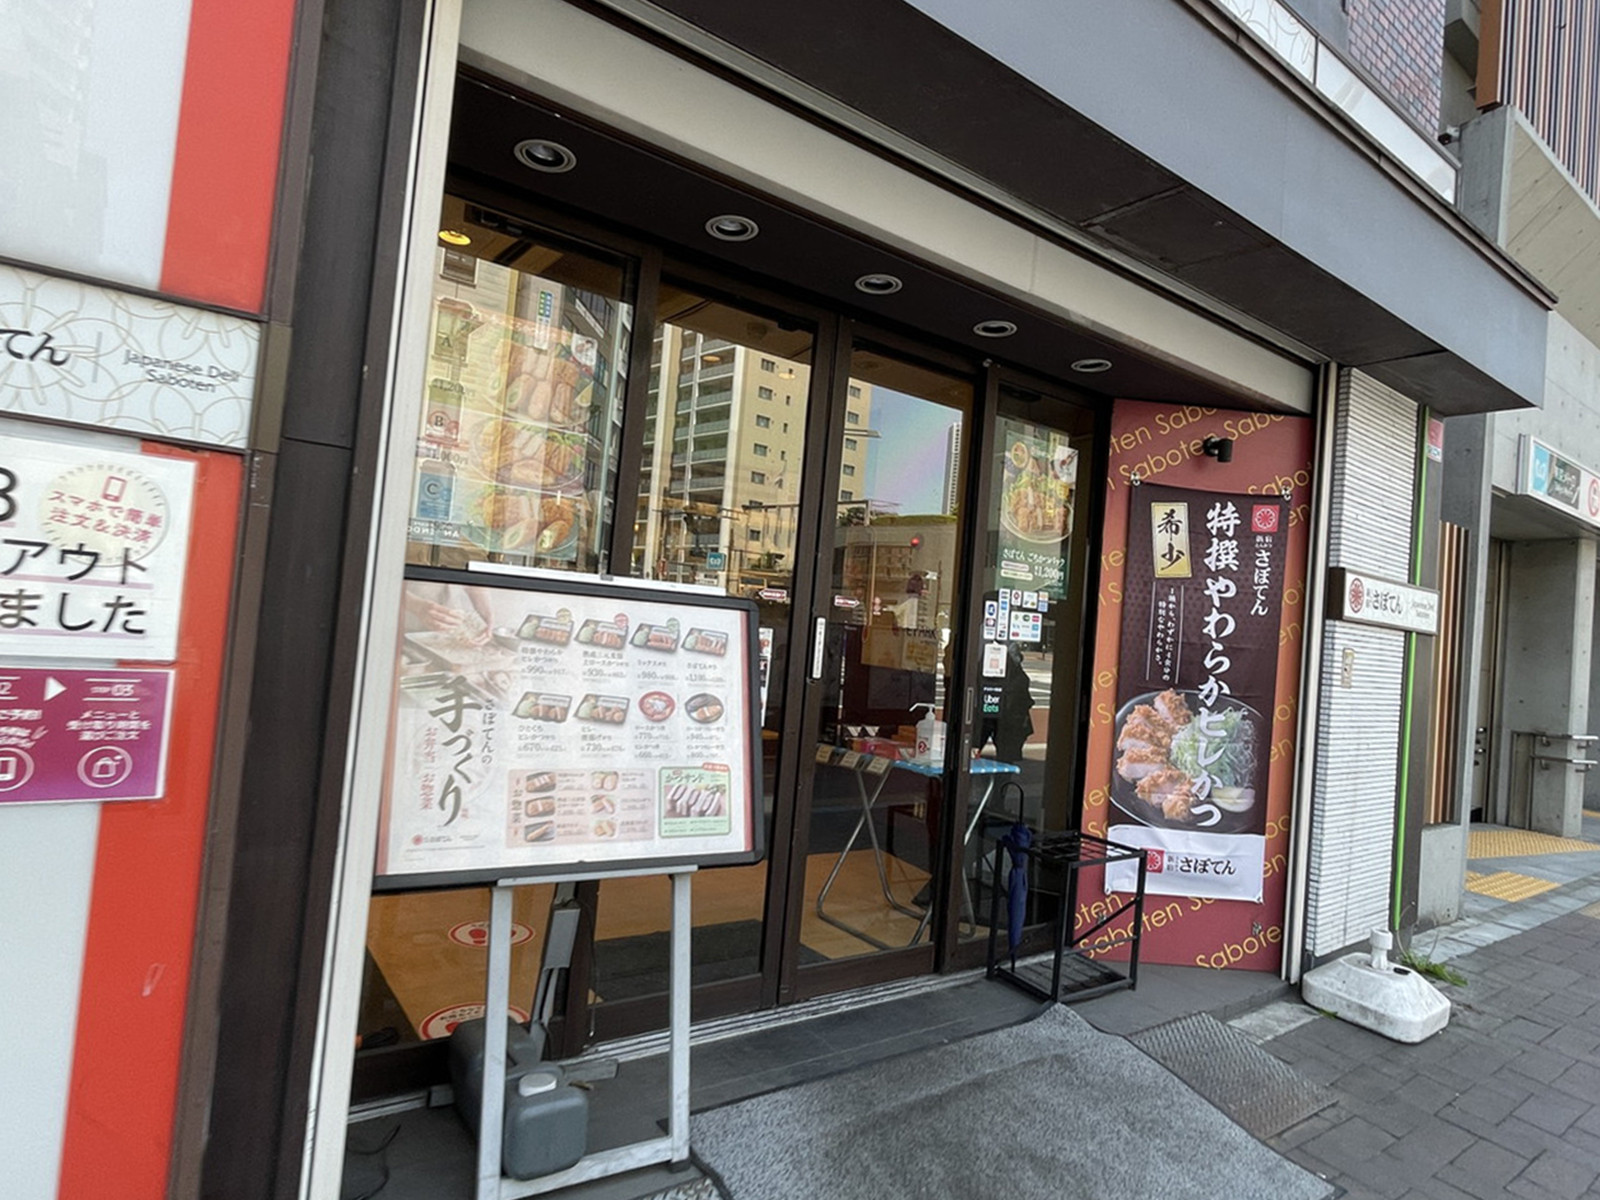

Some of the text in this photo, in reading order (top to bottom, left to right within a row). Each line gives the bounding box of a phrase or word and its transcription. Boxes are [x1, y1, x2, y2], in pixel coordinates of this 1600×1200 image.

[122, 350, 239, 382] Japanese Deli
[146, 368, 216, 393] Saboten
[1109, 426, 1152, 456] ten
[1119, 433, 1217, 486] Sabote
[1157, 508, 1186, 571] 希少
[1, 538, 147, 585] アウト
[1250, 549, 1272, 616] さぼてん
[0, 589, 146, 635] ました
[1372, 590, 1405, 614] さぼてん
[983, 695, 1000, 704] Uber
[983, 704, 999, 713] Eats
[428, 675, 484, 827] 手づくり
[1180, 857, 1236, 875] さぼてん
